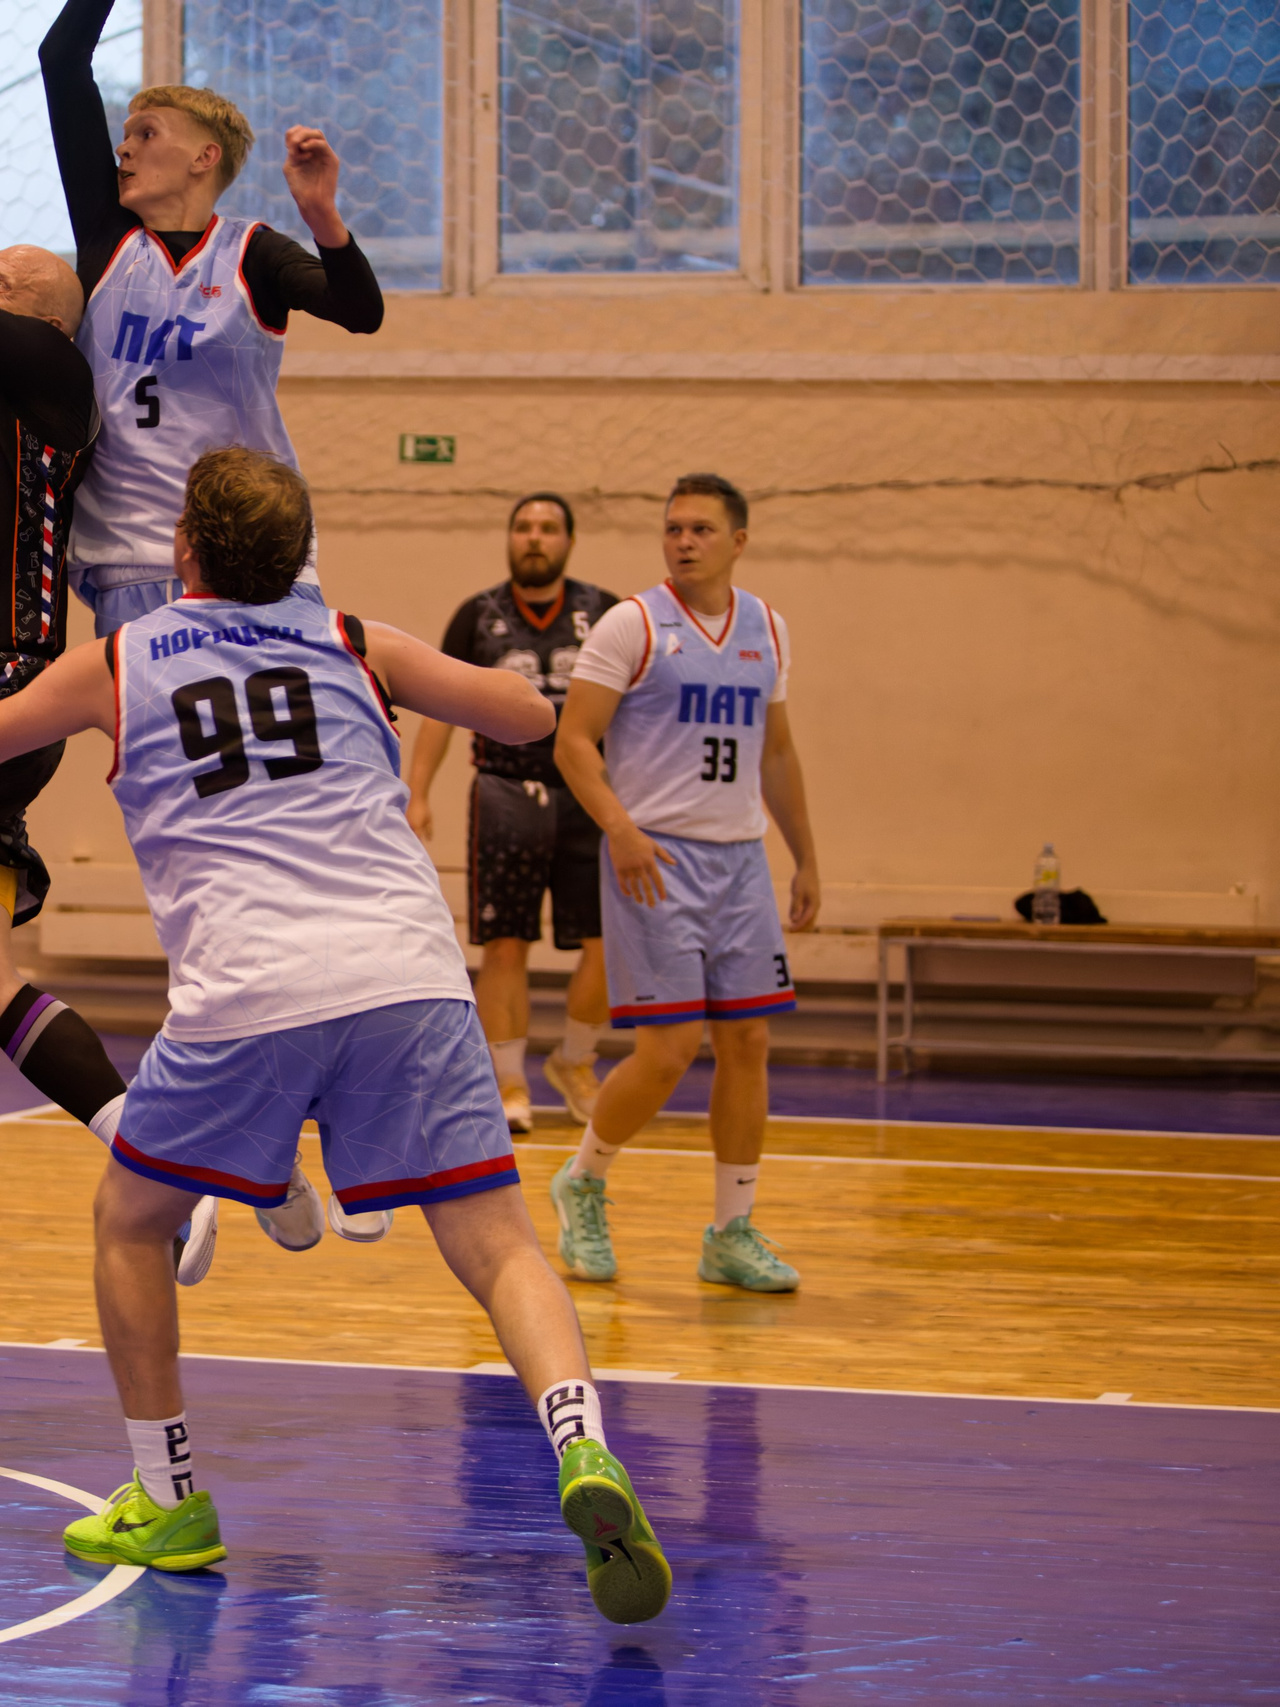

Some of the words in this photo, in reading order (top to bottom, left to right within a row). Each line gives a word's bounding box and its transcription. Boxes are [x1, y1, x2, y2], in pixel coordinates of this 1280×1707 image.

[135, 375, 160, 429] 5
[678, 683, 762, 726] ПАТ
[171, 666, 324, 799] 99
[700, 737, 738, 783] 33
